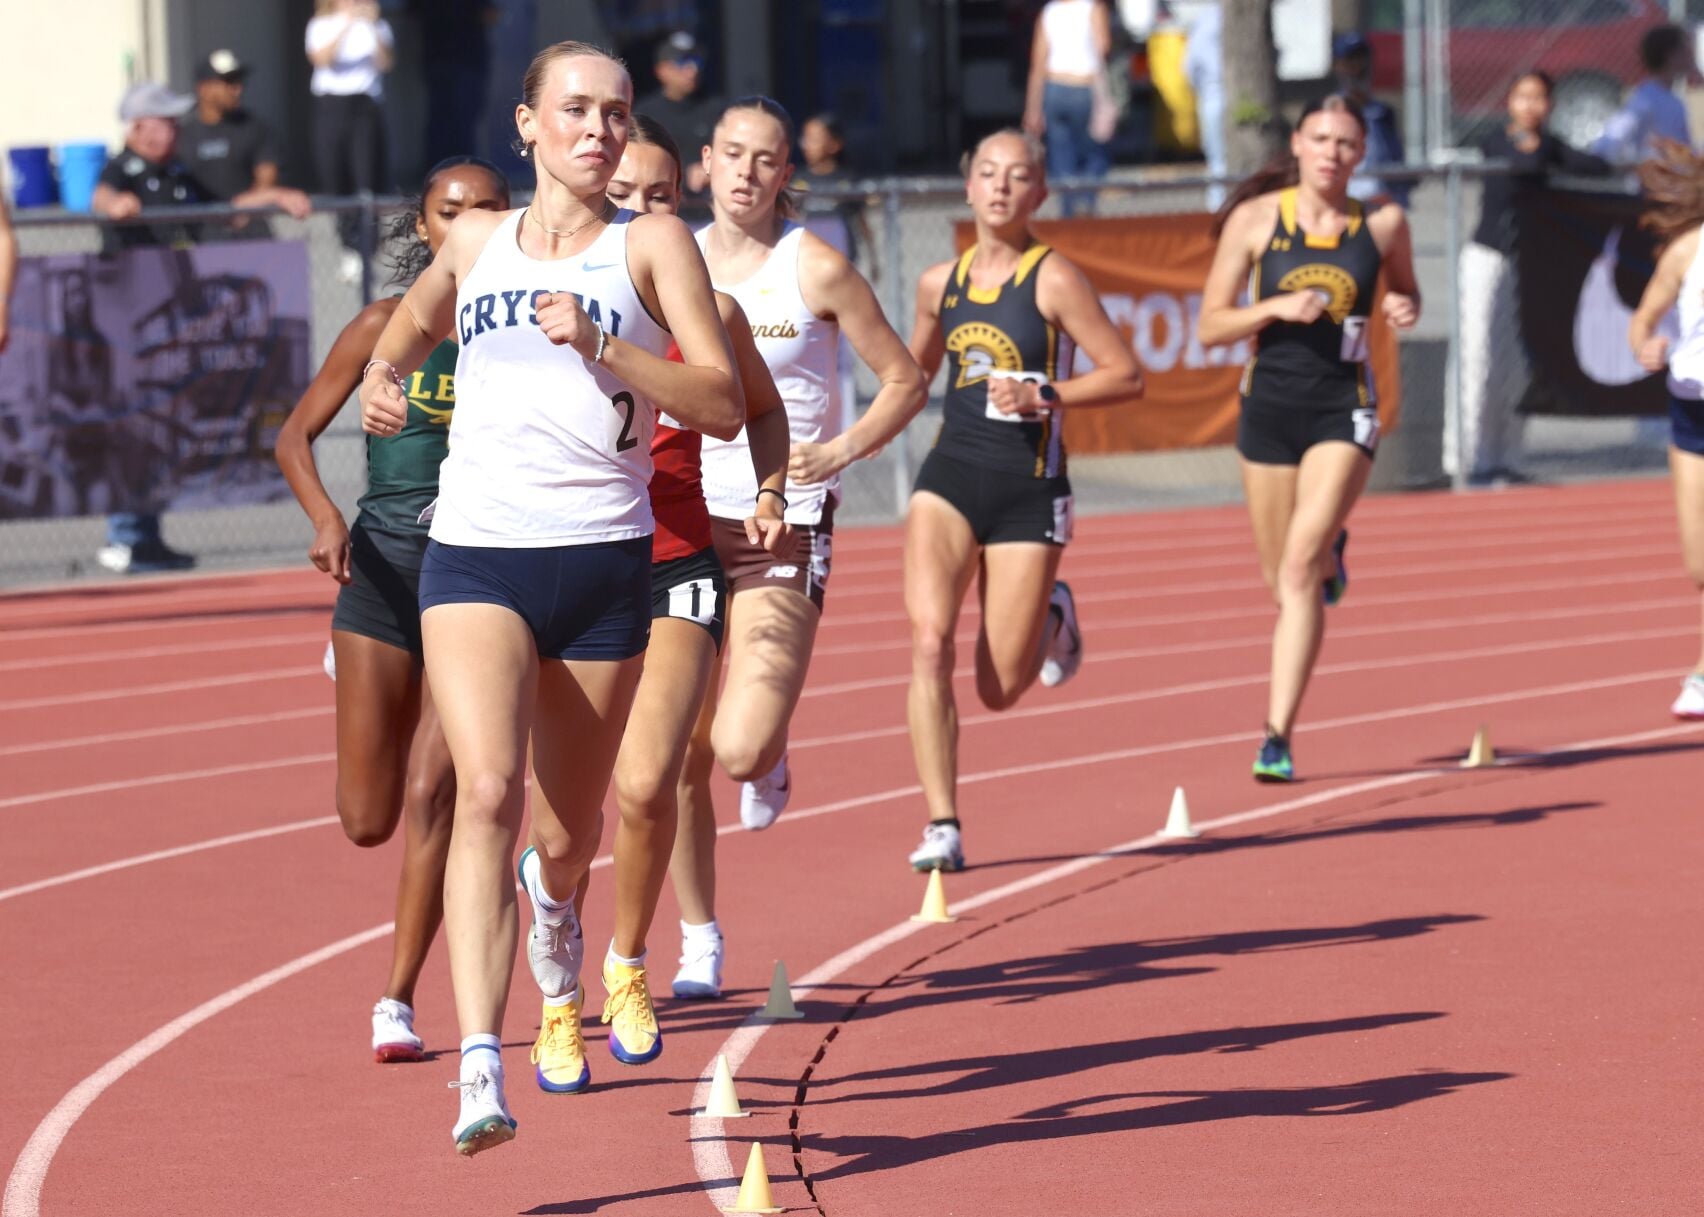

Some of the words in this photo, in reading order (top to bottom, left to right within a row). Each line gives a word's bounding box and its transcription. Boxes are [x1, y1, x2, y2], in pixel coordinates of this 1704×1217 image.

[460, 289, 621, 346] CRYSAL
[611, 390, 638, 453] 2
[687, 581, 702, 618] 1
